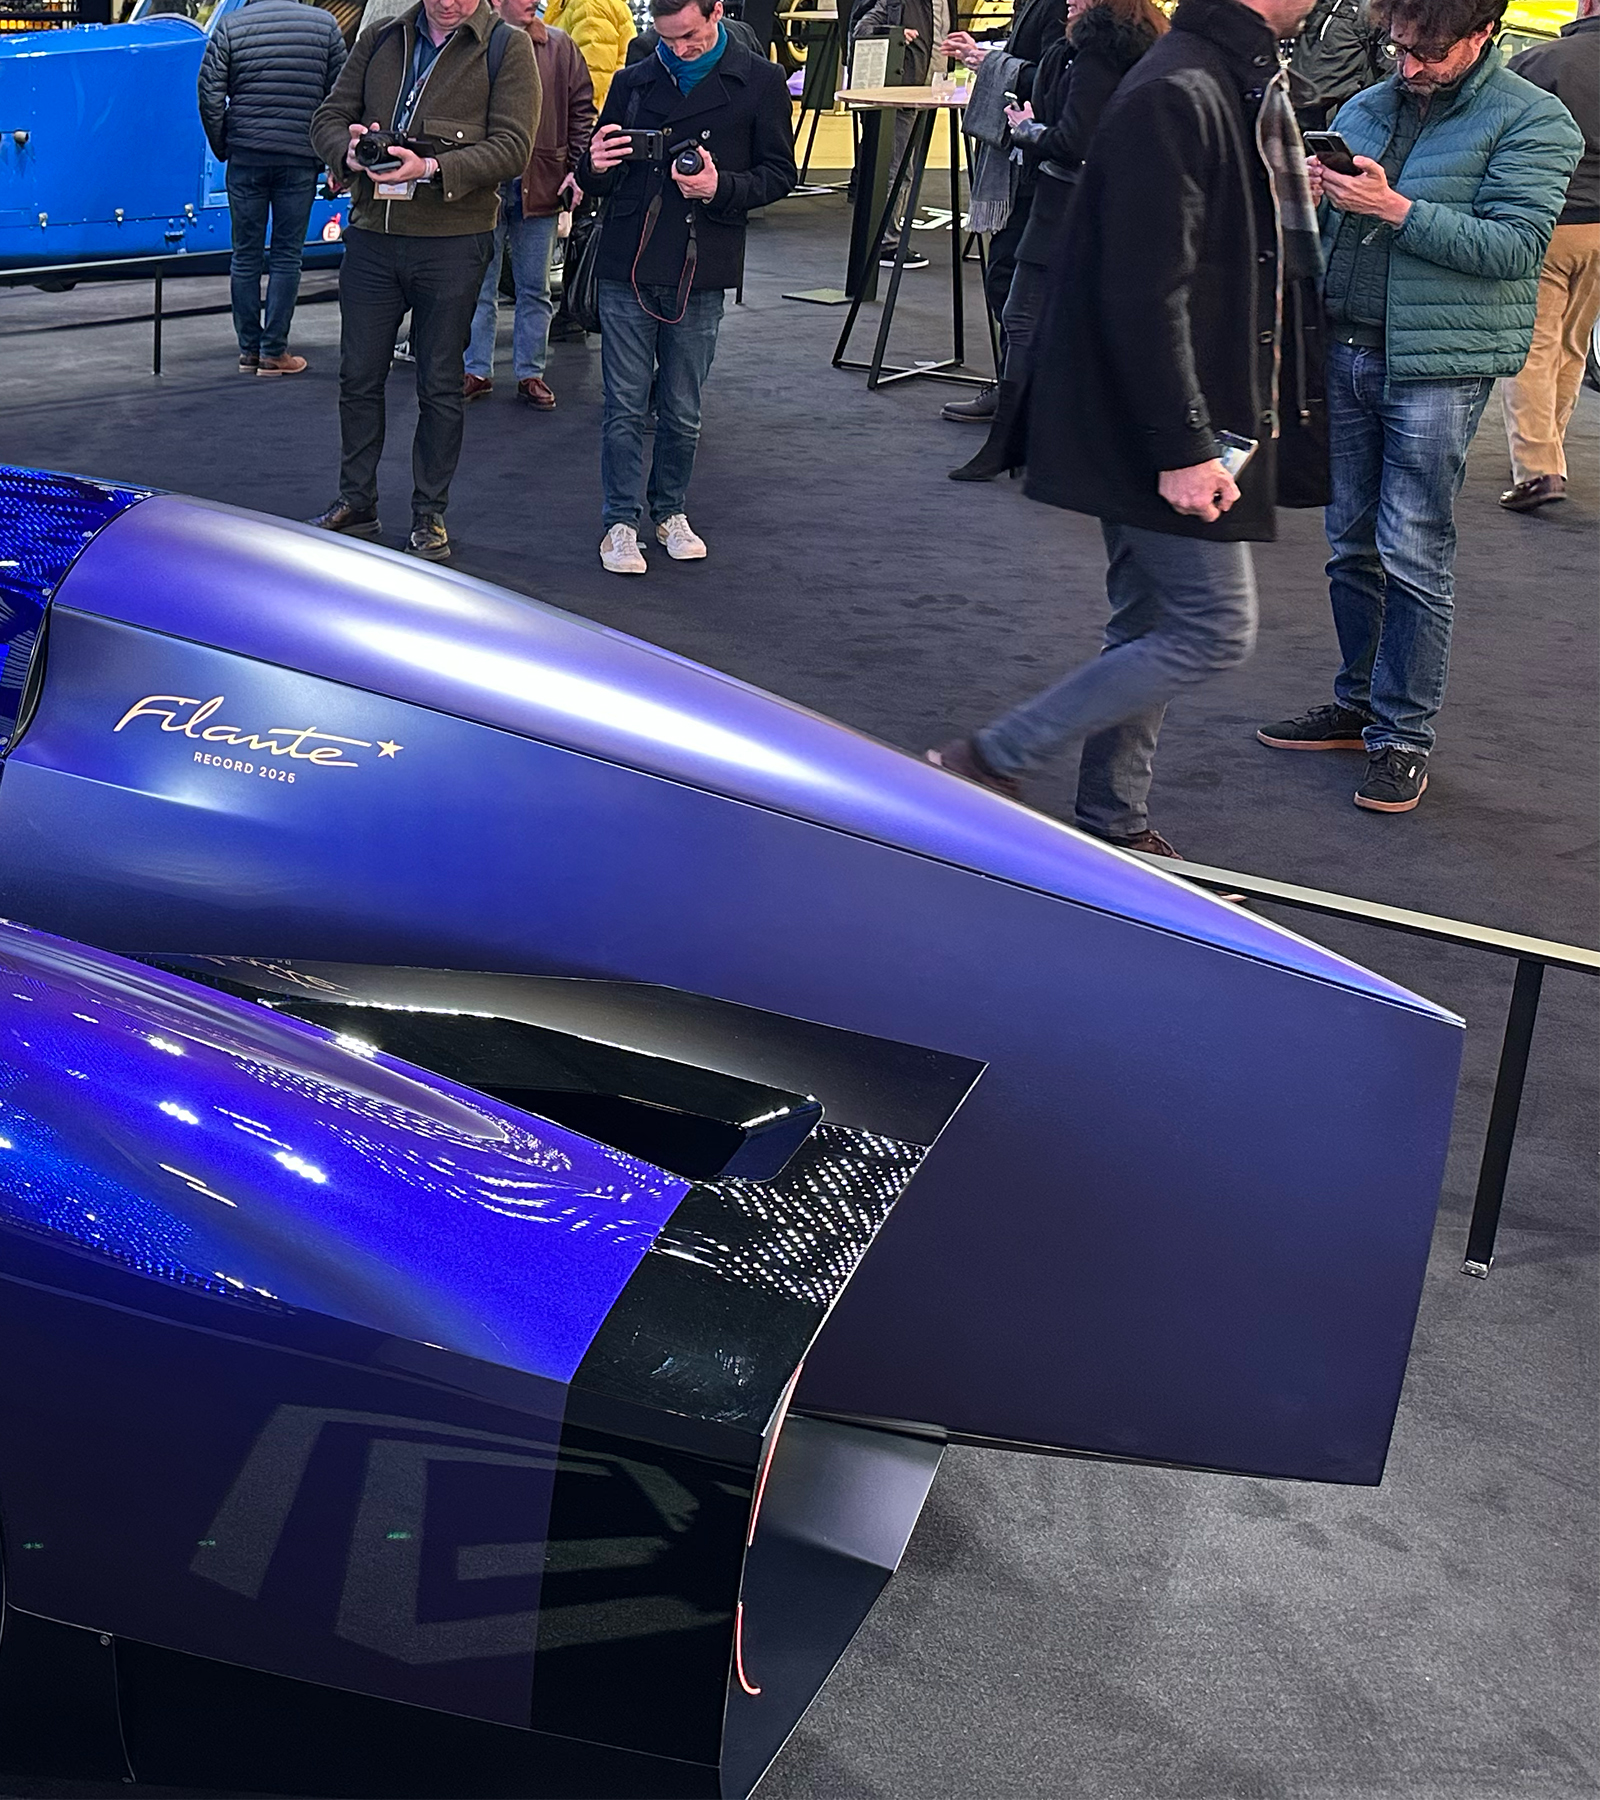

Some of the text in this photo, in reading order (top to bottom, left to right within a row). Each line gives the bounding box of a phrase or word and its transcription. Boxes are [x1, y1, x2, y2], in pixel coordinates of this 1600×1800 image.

[113, 695, 372, 768] Filante
[193, 751, 296, 784] RECORD 2025
